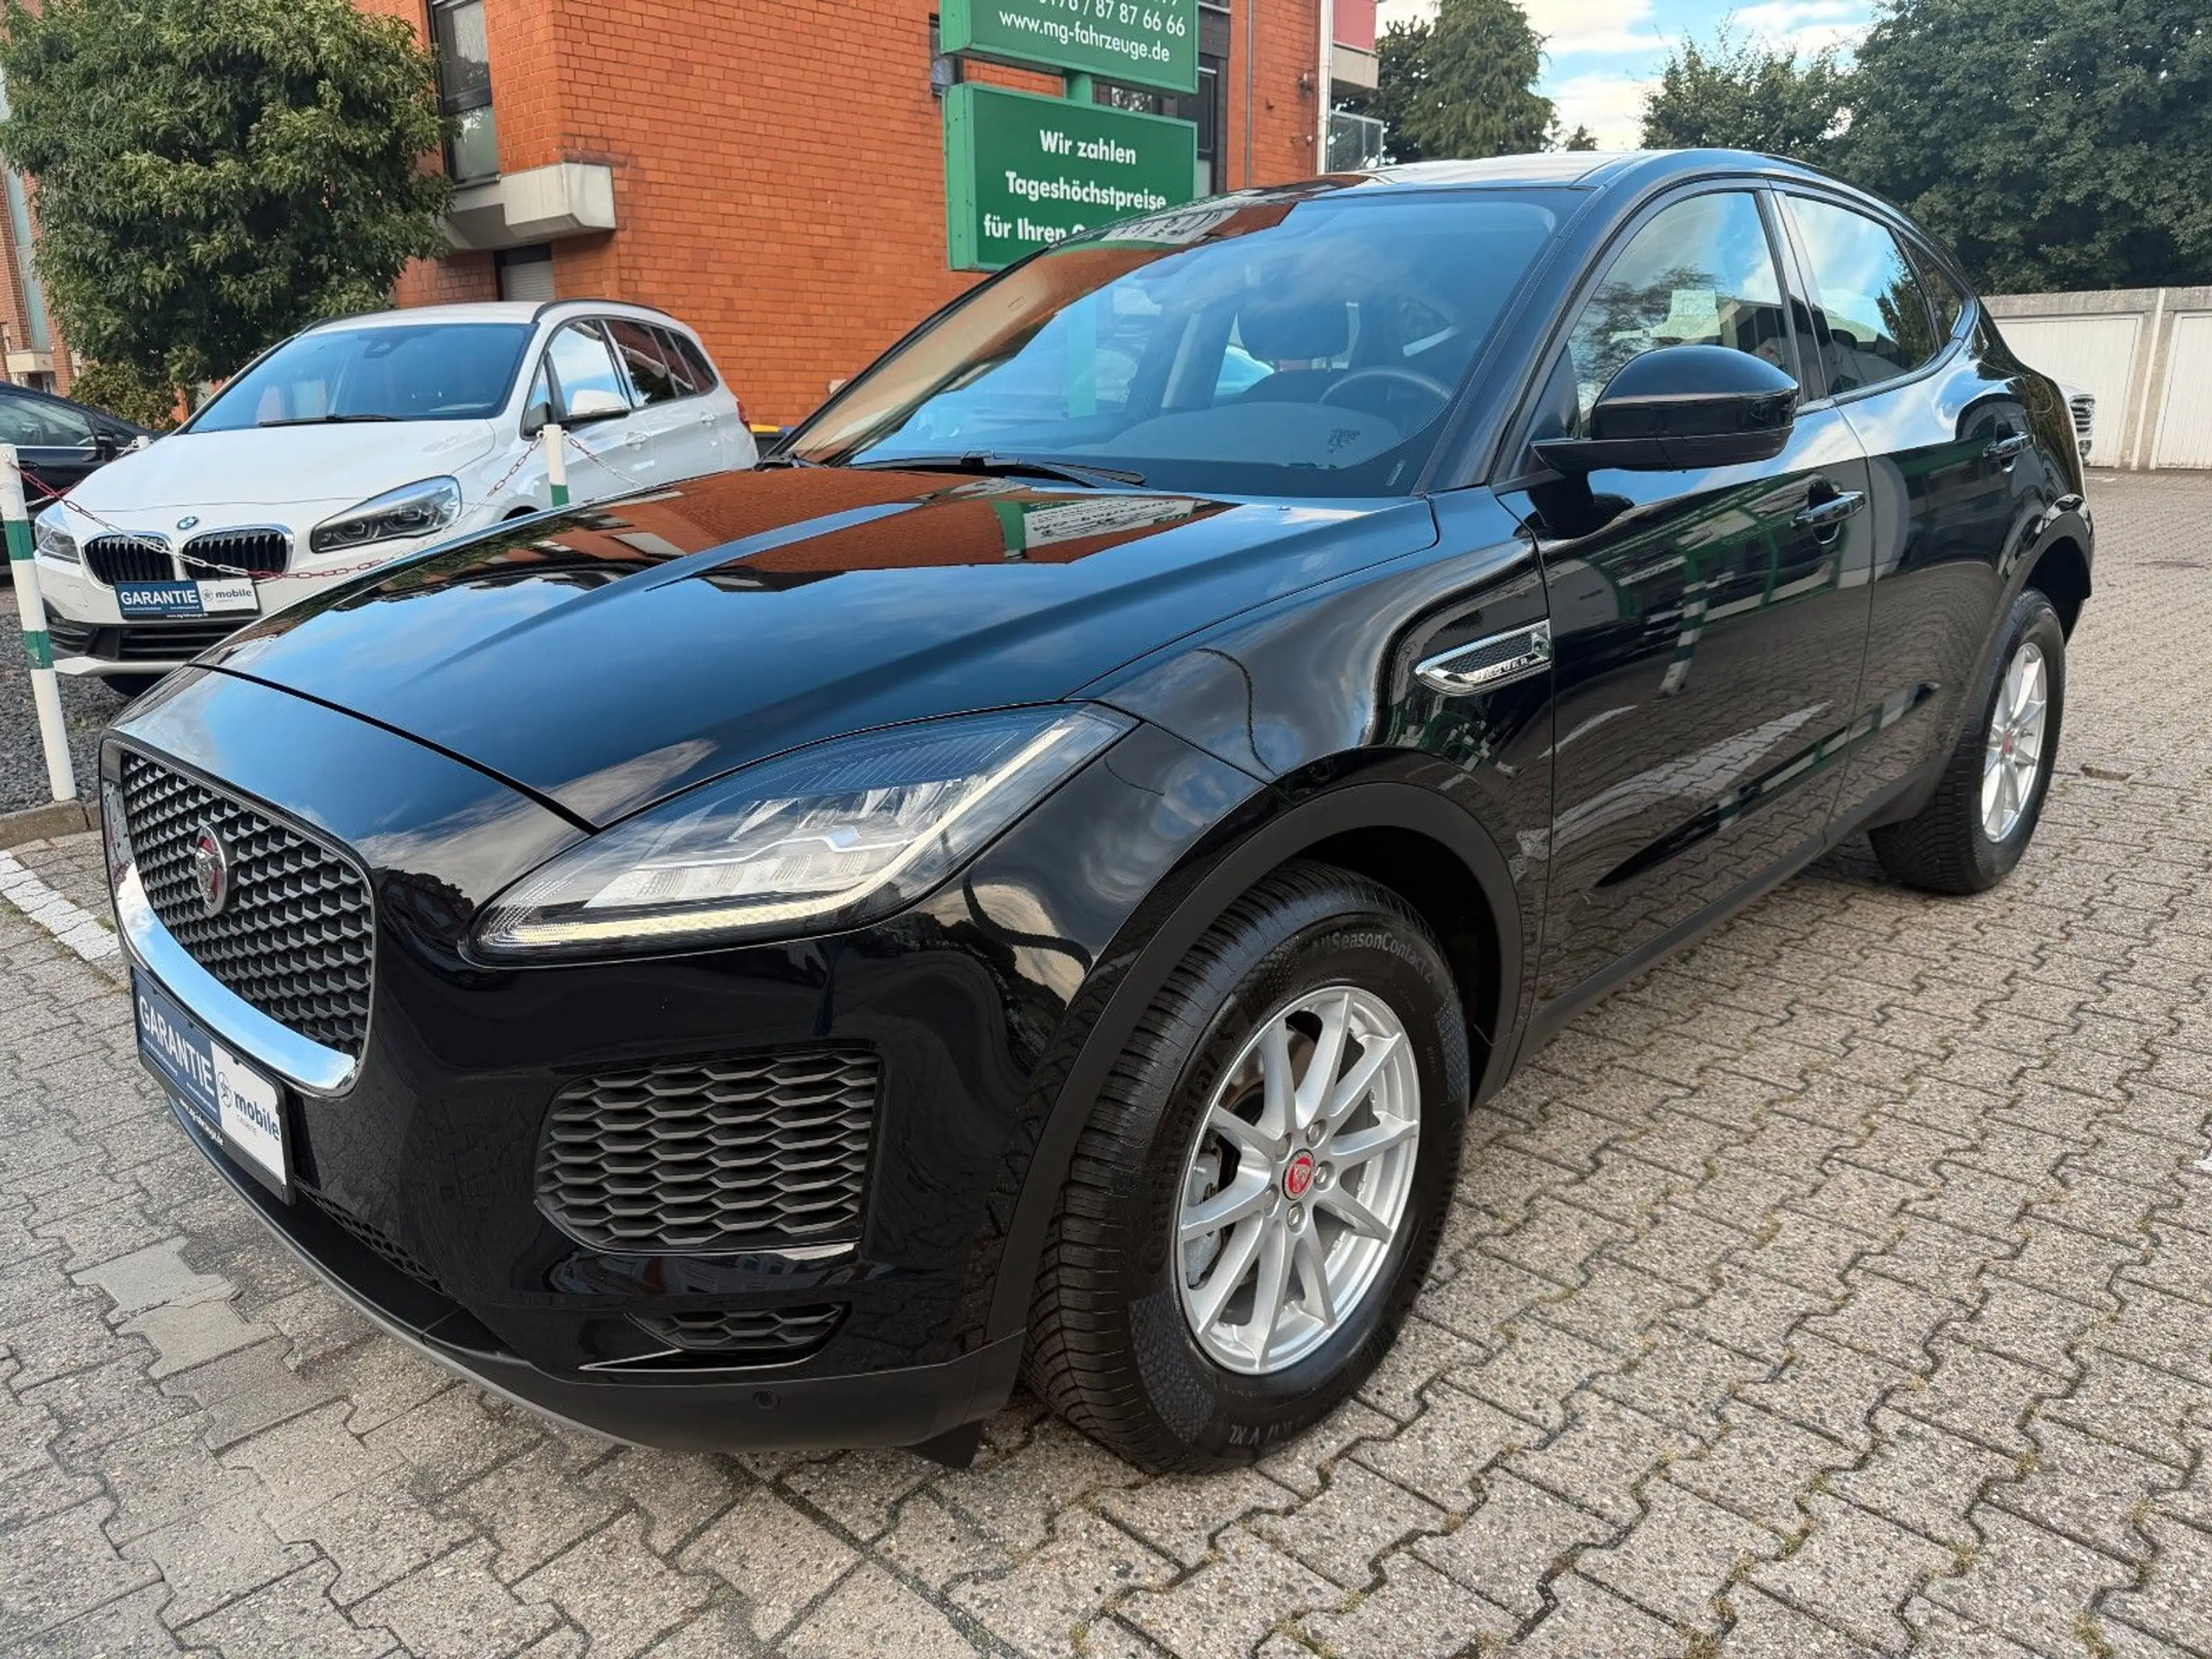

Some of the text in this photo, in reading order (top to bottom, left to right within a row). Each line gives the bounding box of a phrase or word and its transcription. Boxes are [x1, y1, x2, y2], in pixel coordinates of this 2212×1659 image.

[998, 10, 1170, 62] www.mg-fahrzeuge.de
[1096, 0, 1115, 20] 87
[1119, 2, 1138, 25] 87
[1143, 8, 1162, 31] 66
[1166, 14, 1185, 37] 66
[1039, 129, 1136, 165] Wir zahlen
[1005, 171, 1166, 211] Tageshöchstpreise
[983, 213, 1012, 238] für
[1017, 217, 1067, 243] Ihren
[120, 589, 199, 605] GARANTIE
[215, 588, 252, 599] mobile
[139, 995, 215, 1097] GARANTIE
[233, 1090, 281, 1142] mobile
